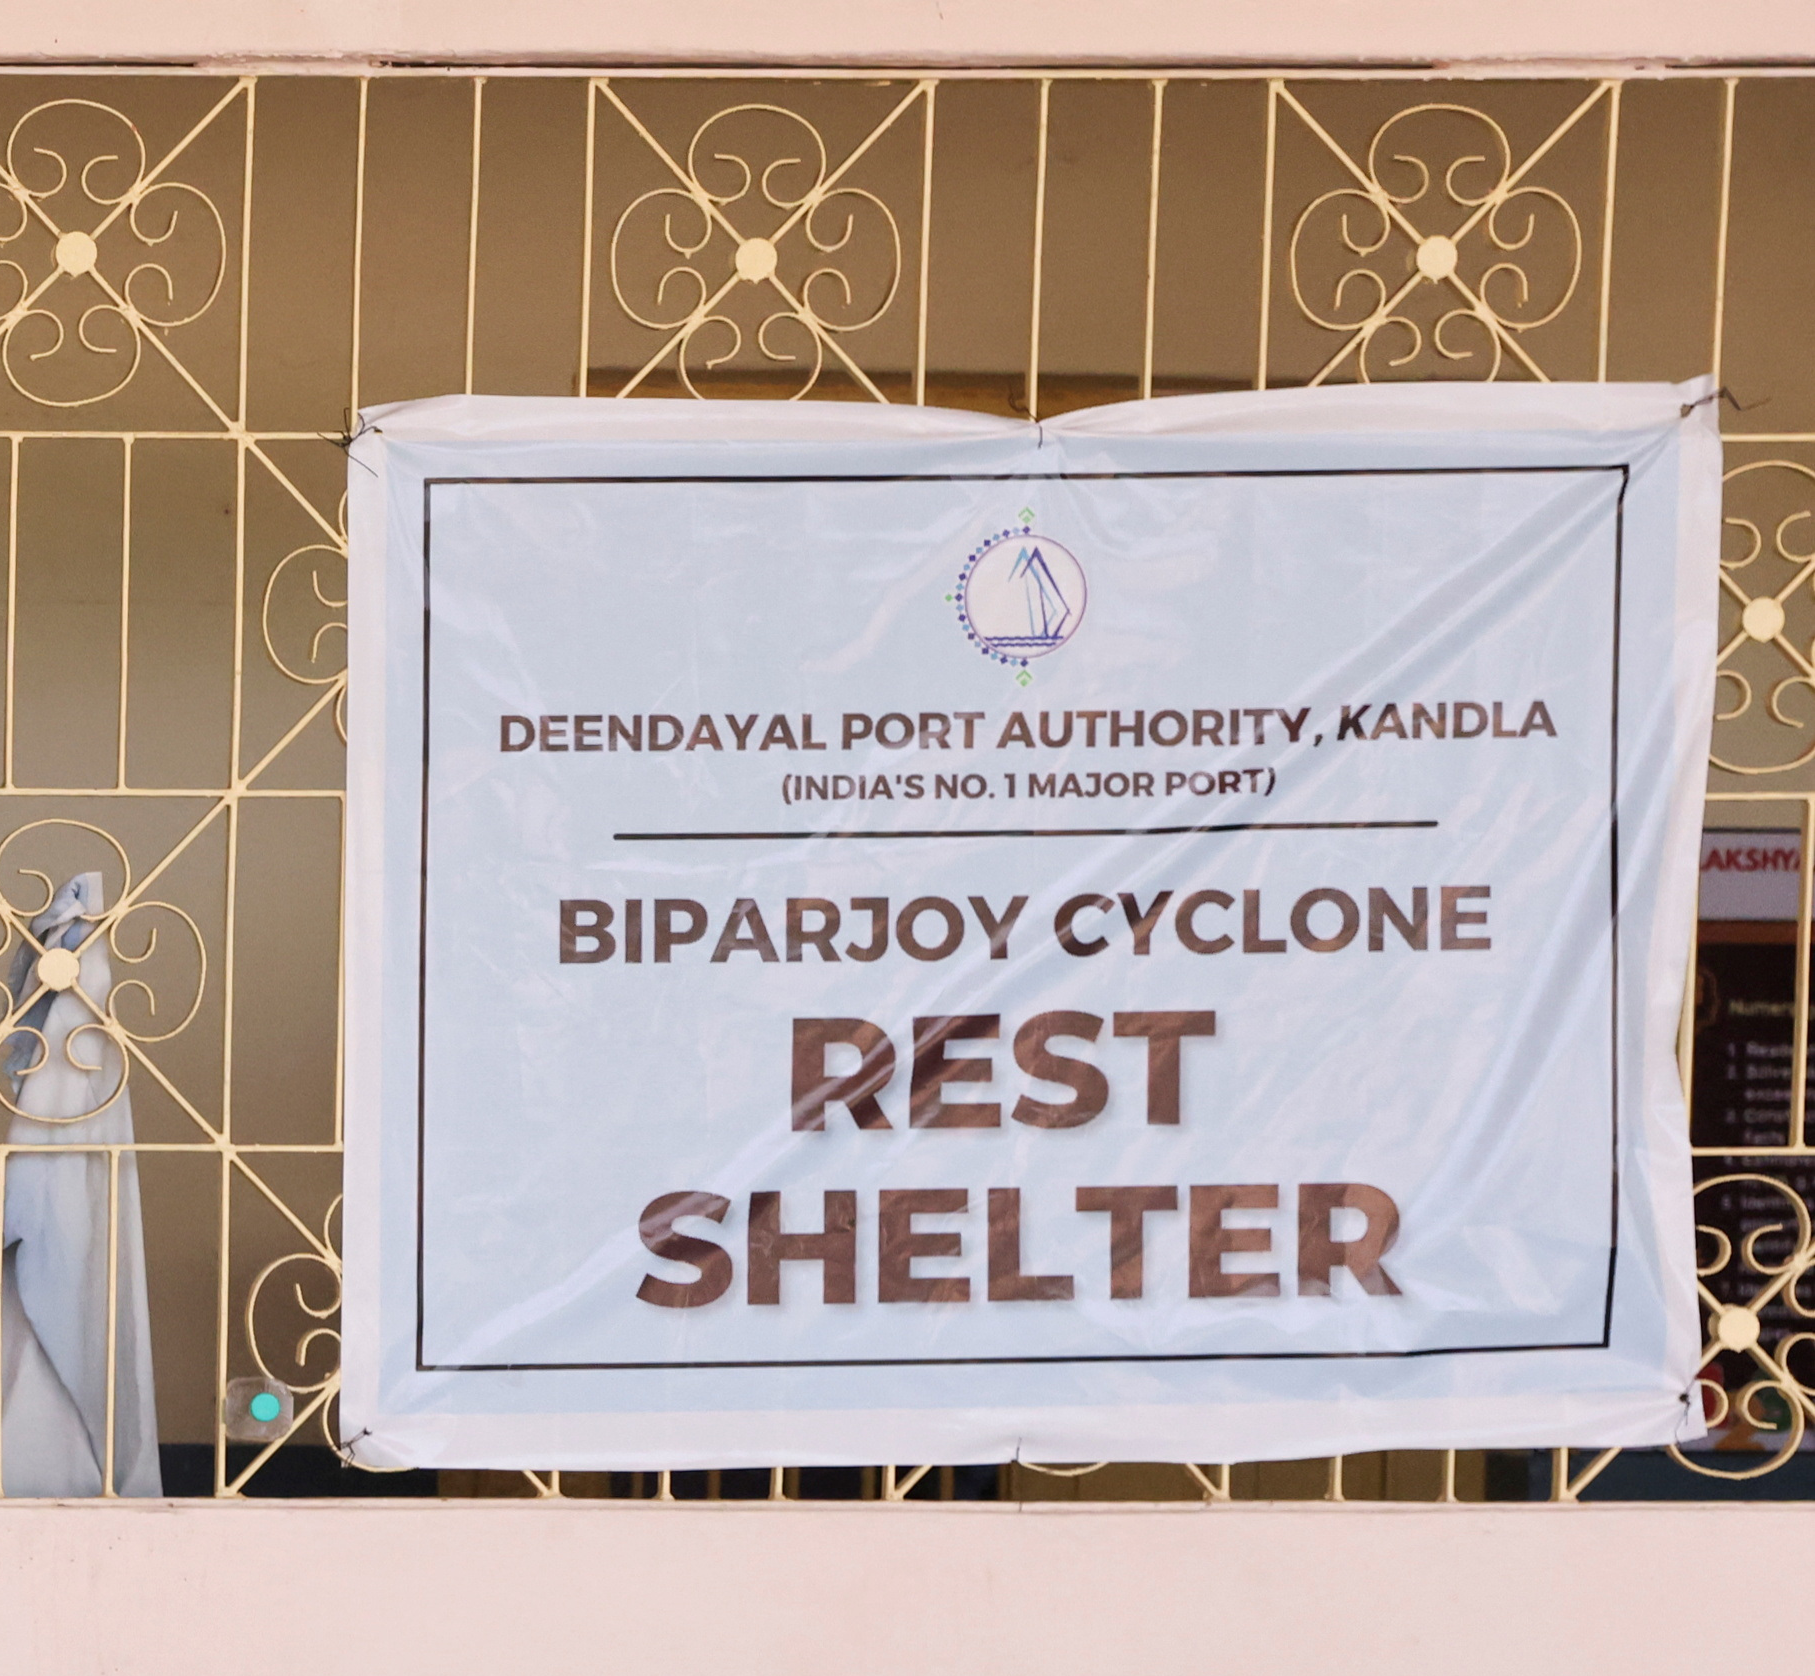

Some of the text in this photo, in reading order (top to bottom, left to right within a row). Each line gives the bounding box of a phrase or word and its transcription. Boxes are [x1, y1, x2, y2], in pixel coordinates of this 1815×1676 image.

[500, 701, 1556, 752] DEENDAYAL PORT AUTHORITY, KANDLA
[782, 768, 1276, 805] (INDIA'S NO. 1 MAJOR PORT)
[1701, 847, 1800, 872] AKSHY
[559, 886, 1491, 964] BIPARJOY CYCLONE
[791, 1010, 1216, 1132] REST
[636, 1183, 1402, 1308] SHELTER
